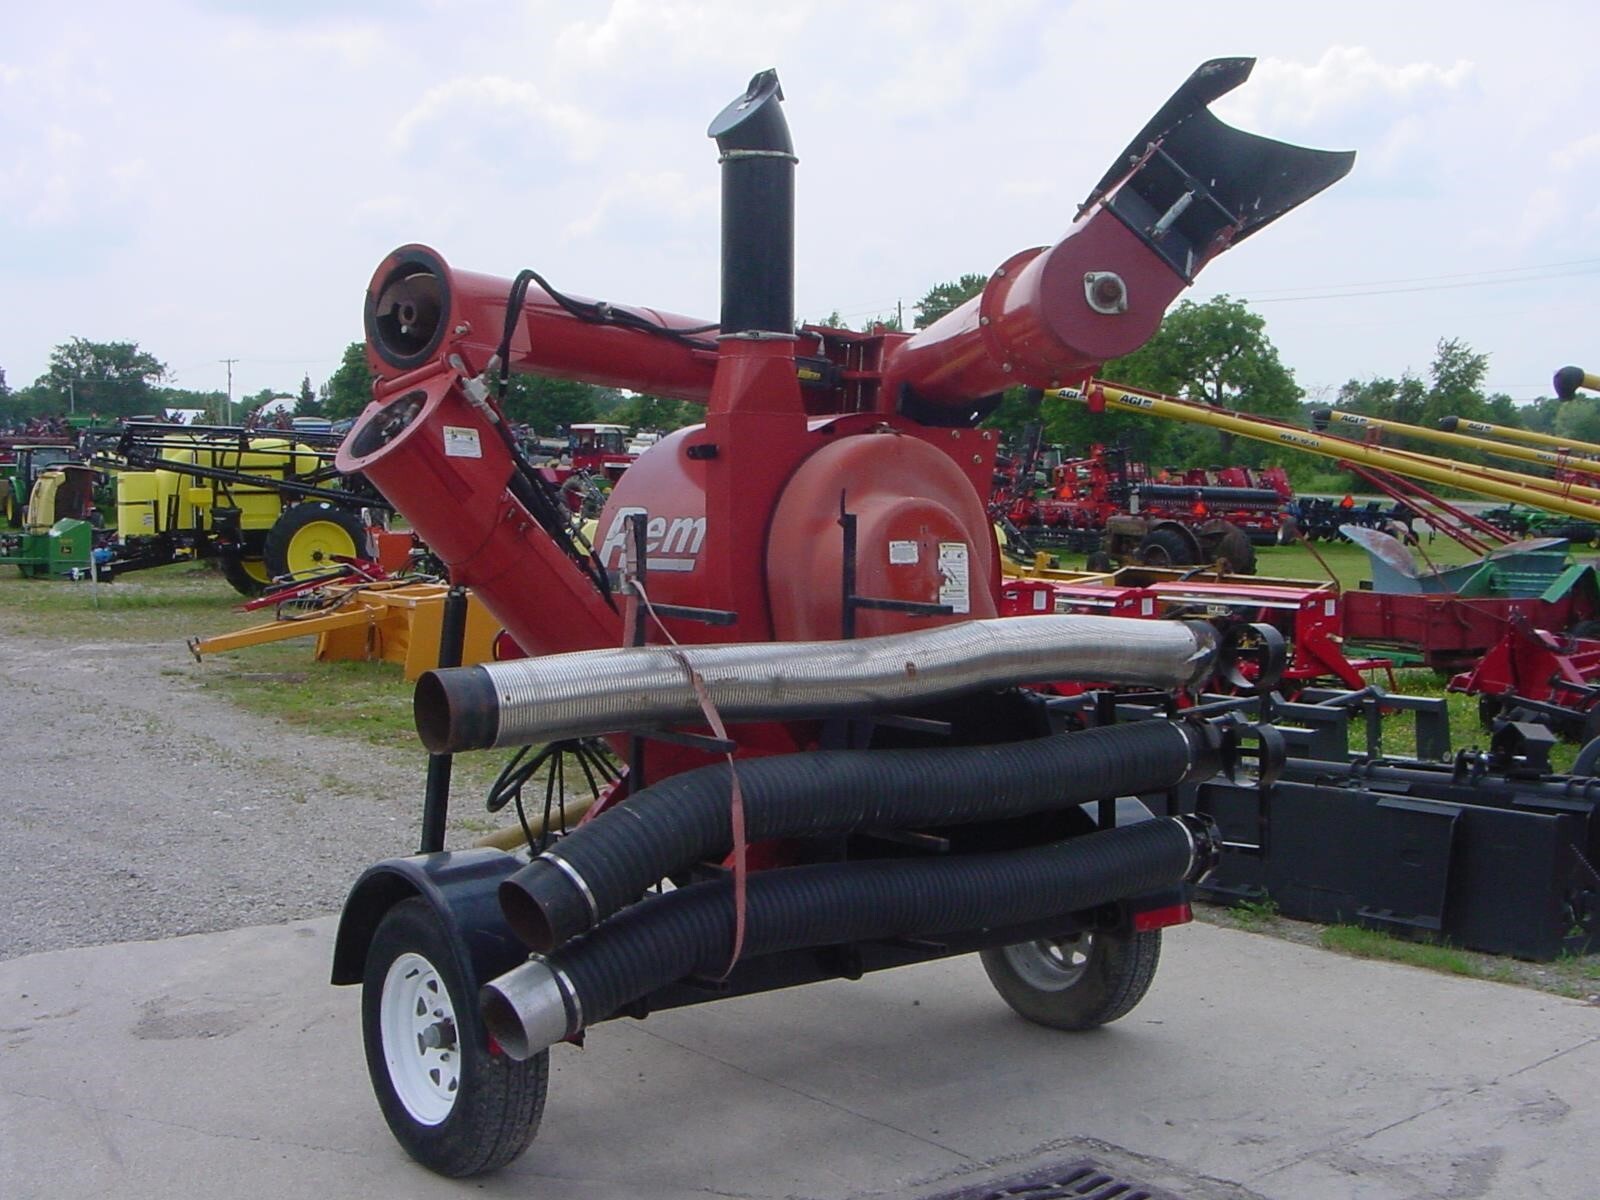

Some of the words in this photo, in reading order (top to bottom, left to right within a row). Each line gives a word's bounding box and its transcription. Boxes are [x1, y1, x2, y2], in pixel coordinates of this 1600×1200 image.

[1058, 389, 1077, 399] AGI
[1119, 394, 1142, 407] AGI
[1341, 415, 1360, 424] AGI
